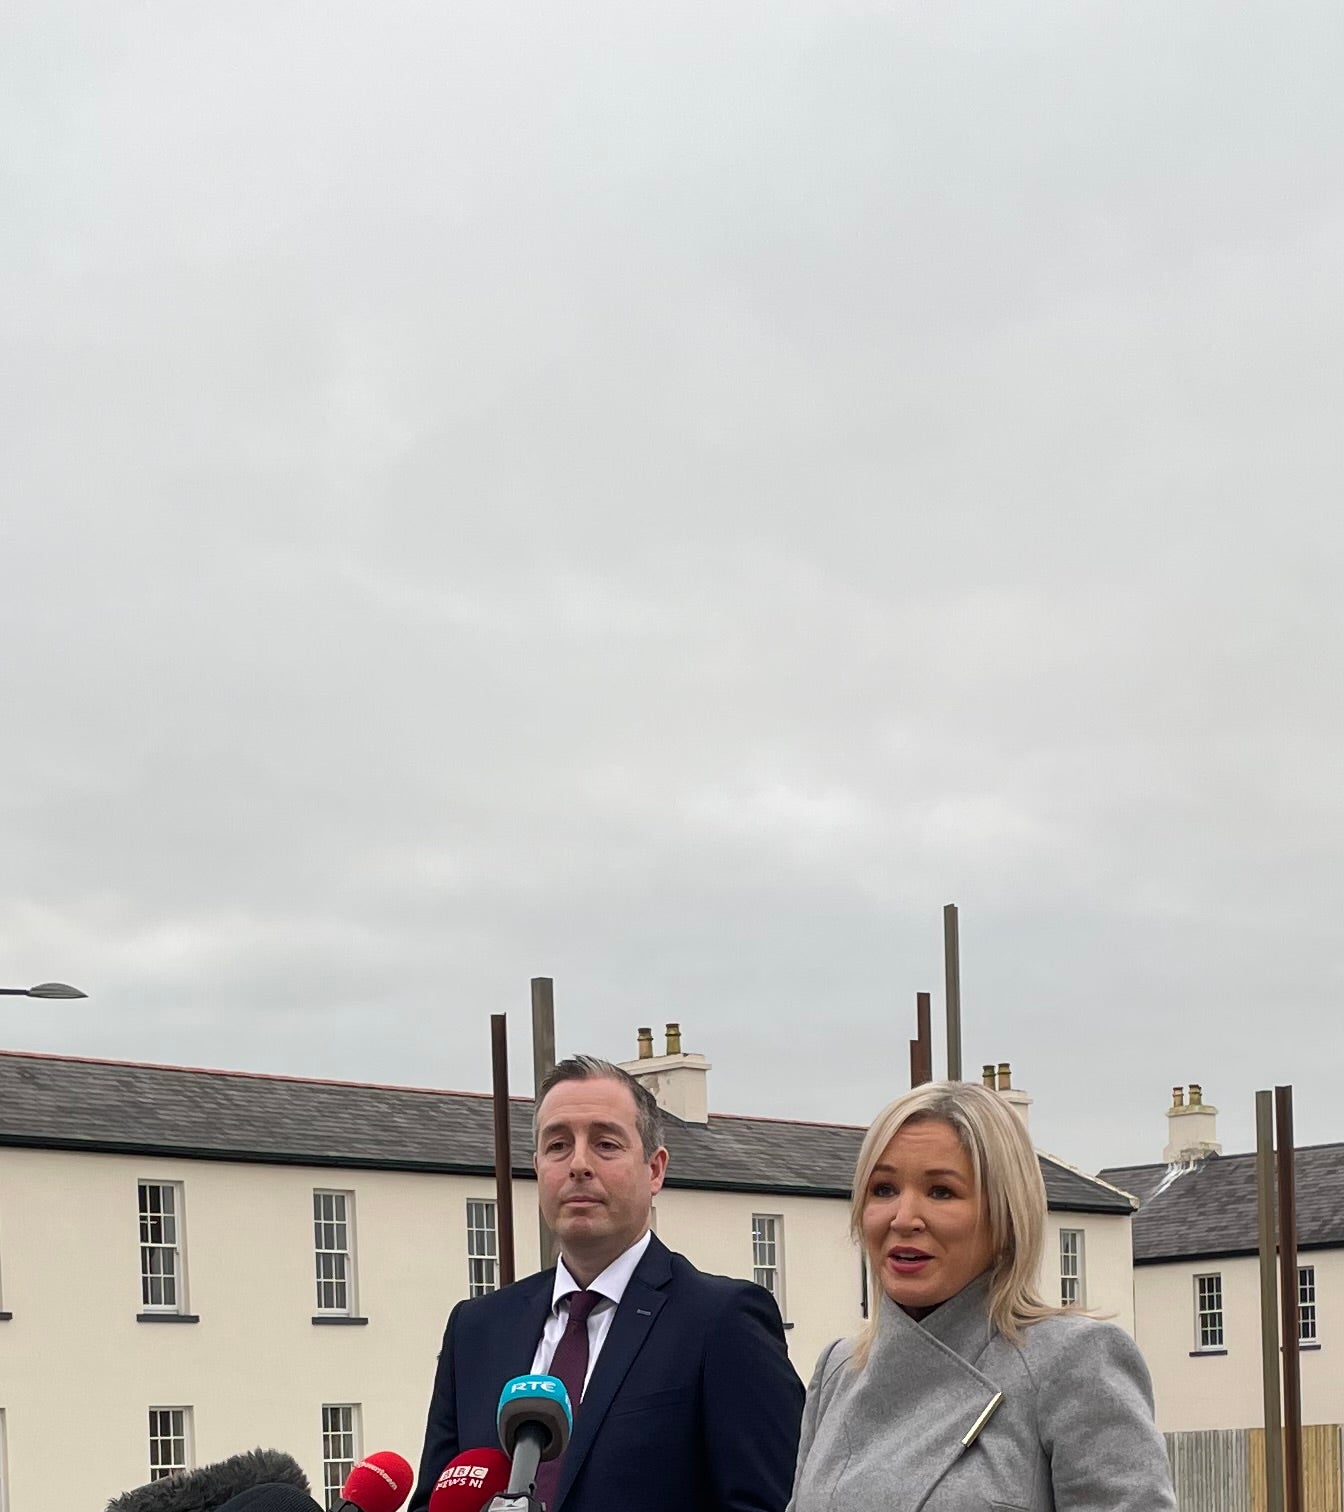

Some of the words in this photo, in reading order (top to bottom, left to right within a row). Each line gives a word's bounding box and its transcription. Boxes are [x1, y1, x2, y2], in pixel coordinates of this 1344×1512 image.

[355, 1460, 398, 1491] owntown
[439, 1465, 489, 1482] BBC
[435, 1477, 467, 1491] NEWS
[468, 1478, 484, 1489] NI
